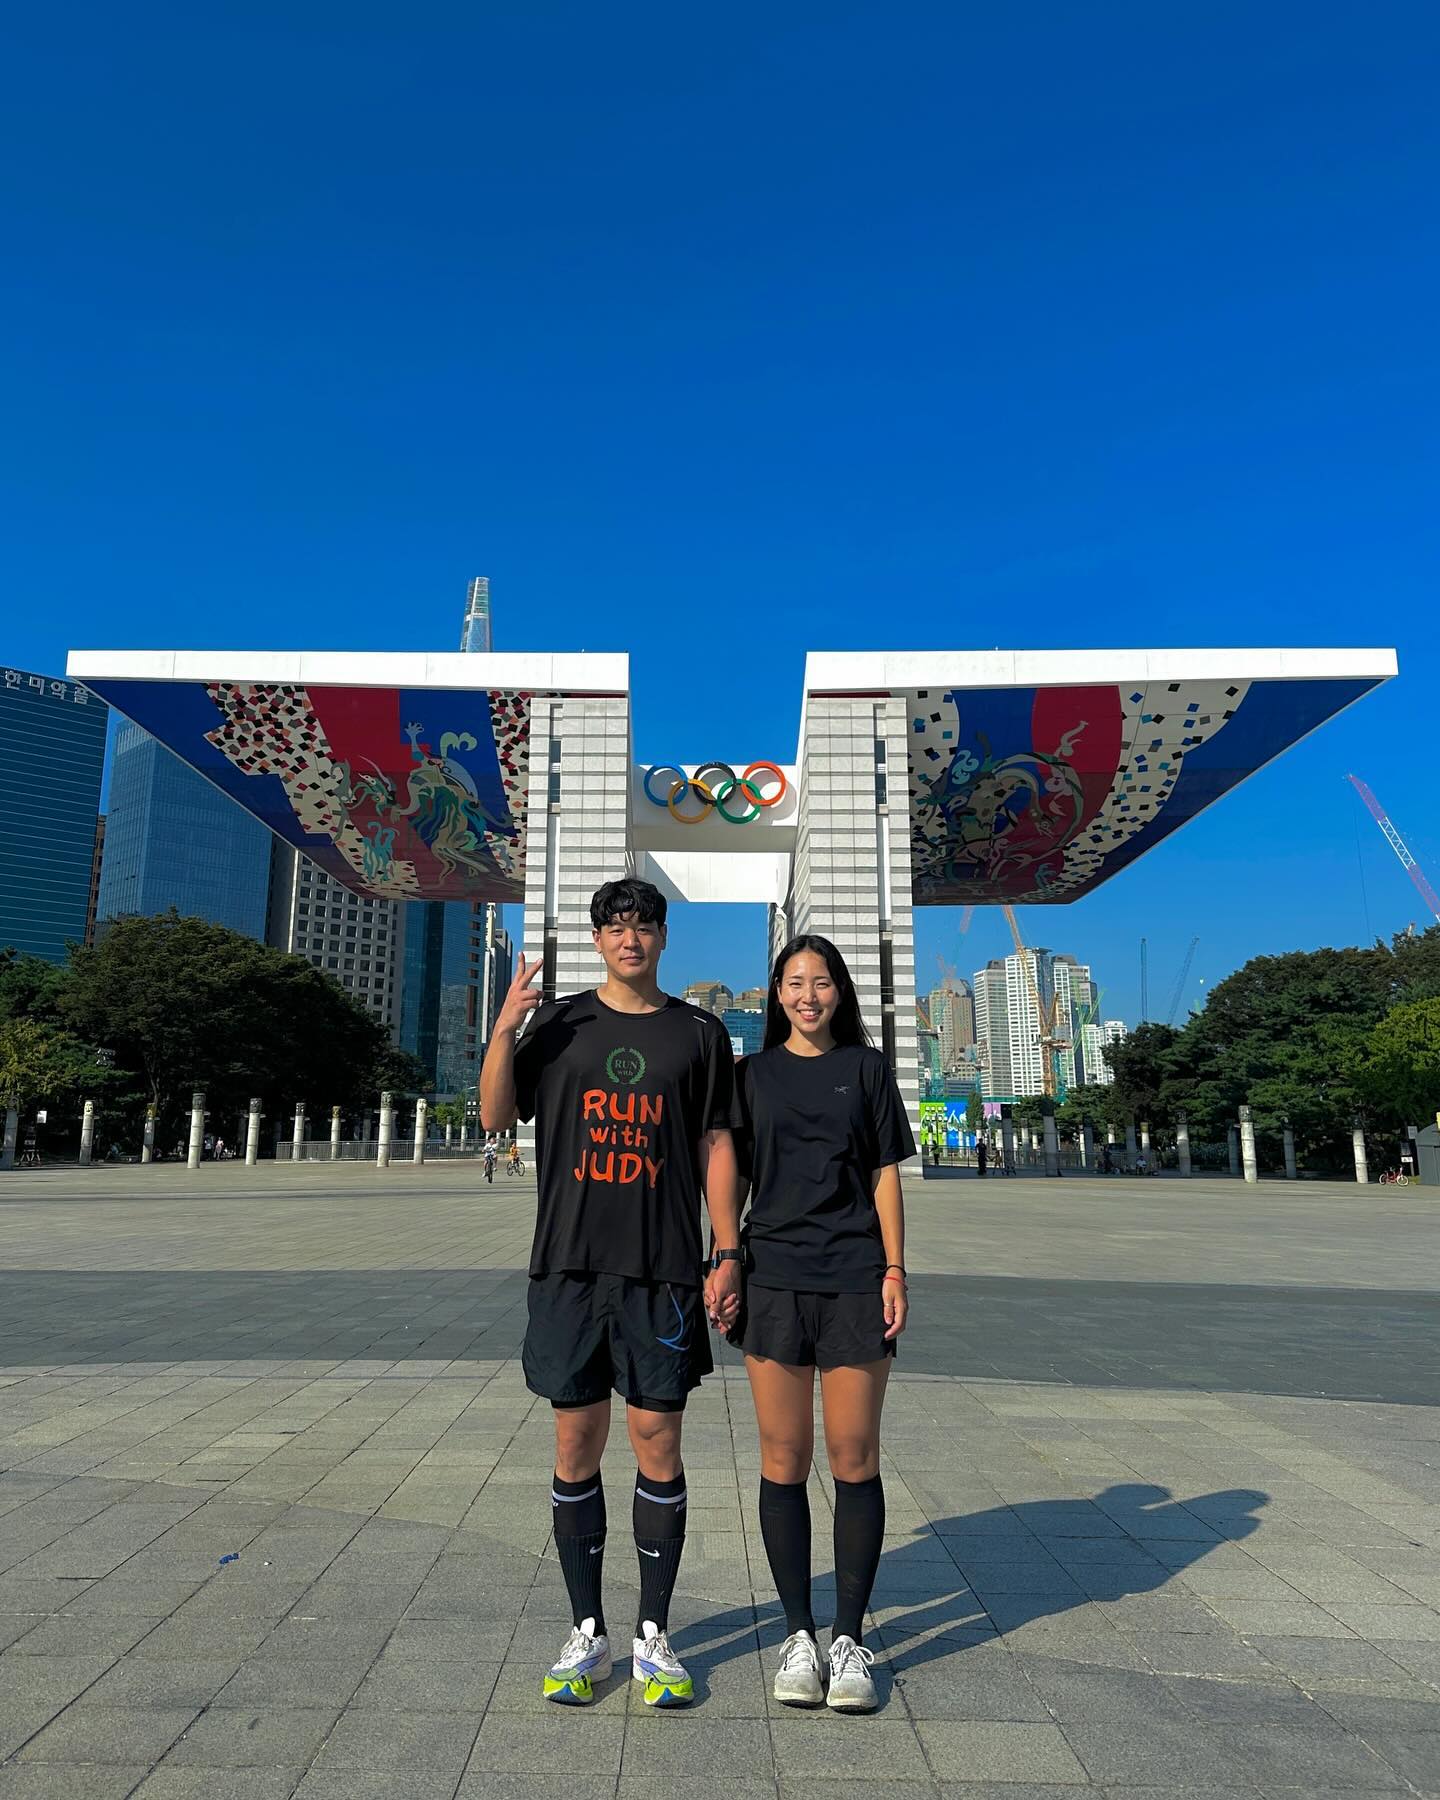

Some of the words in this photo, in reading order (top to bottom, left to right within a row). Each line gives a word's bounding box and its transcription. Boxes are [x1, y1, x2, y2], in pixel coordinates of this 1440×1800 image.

[5, 670, 88, 705] 한미약품
[615, 1059, 638, 1070] RUN
[583, 1089, 663, 1126] RUN
[590, 1124, 648, 1148] with
[574, 1149, 664, 1188] JUDY
